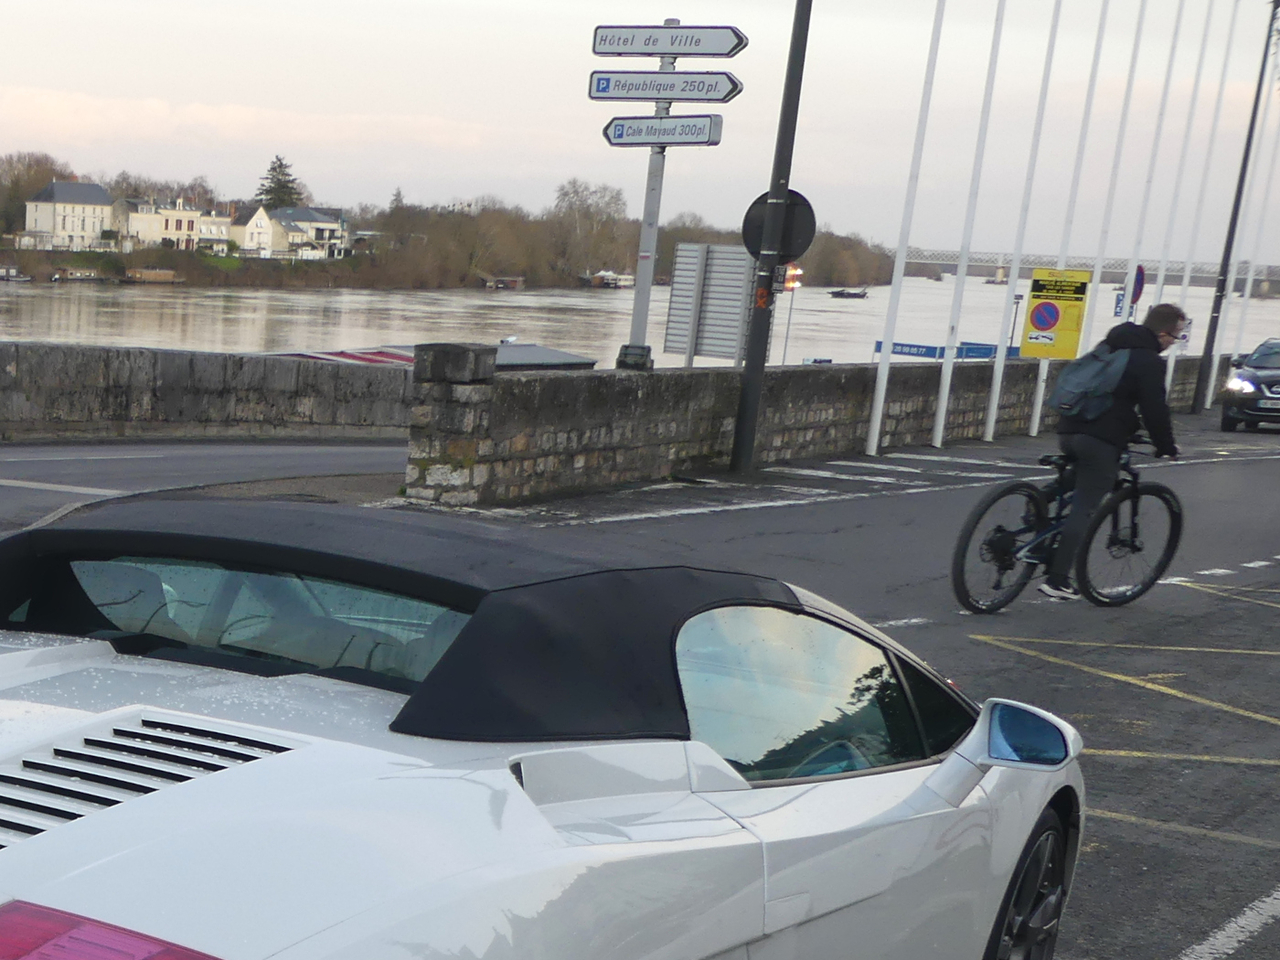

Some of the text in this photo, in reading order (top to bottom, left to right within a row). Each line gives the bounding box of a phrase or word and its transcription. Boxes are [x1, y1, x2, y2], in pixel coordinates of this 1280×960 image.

[598, 35, 701, 47] Hôtel de Ville
[613, 79, 675, 95] République
[626, 126, 644, 137] Cale
[644, 125, 677, 139] Mayaud
